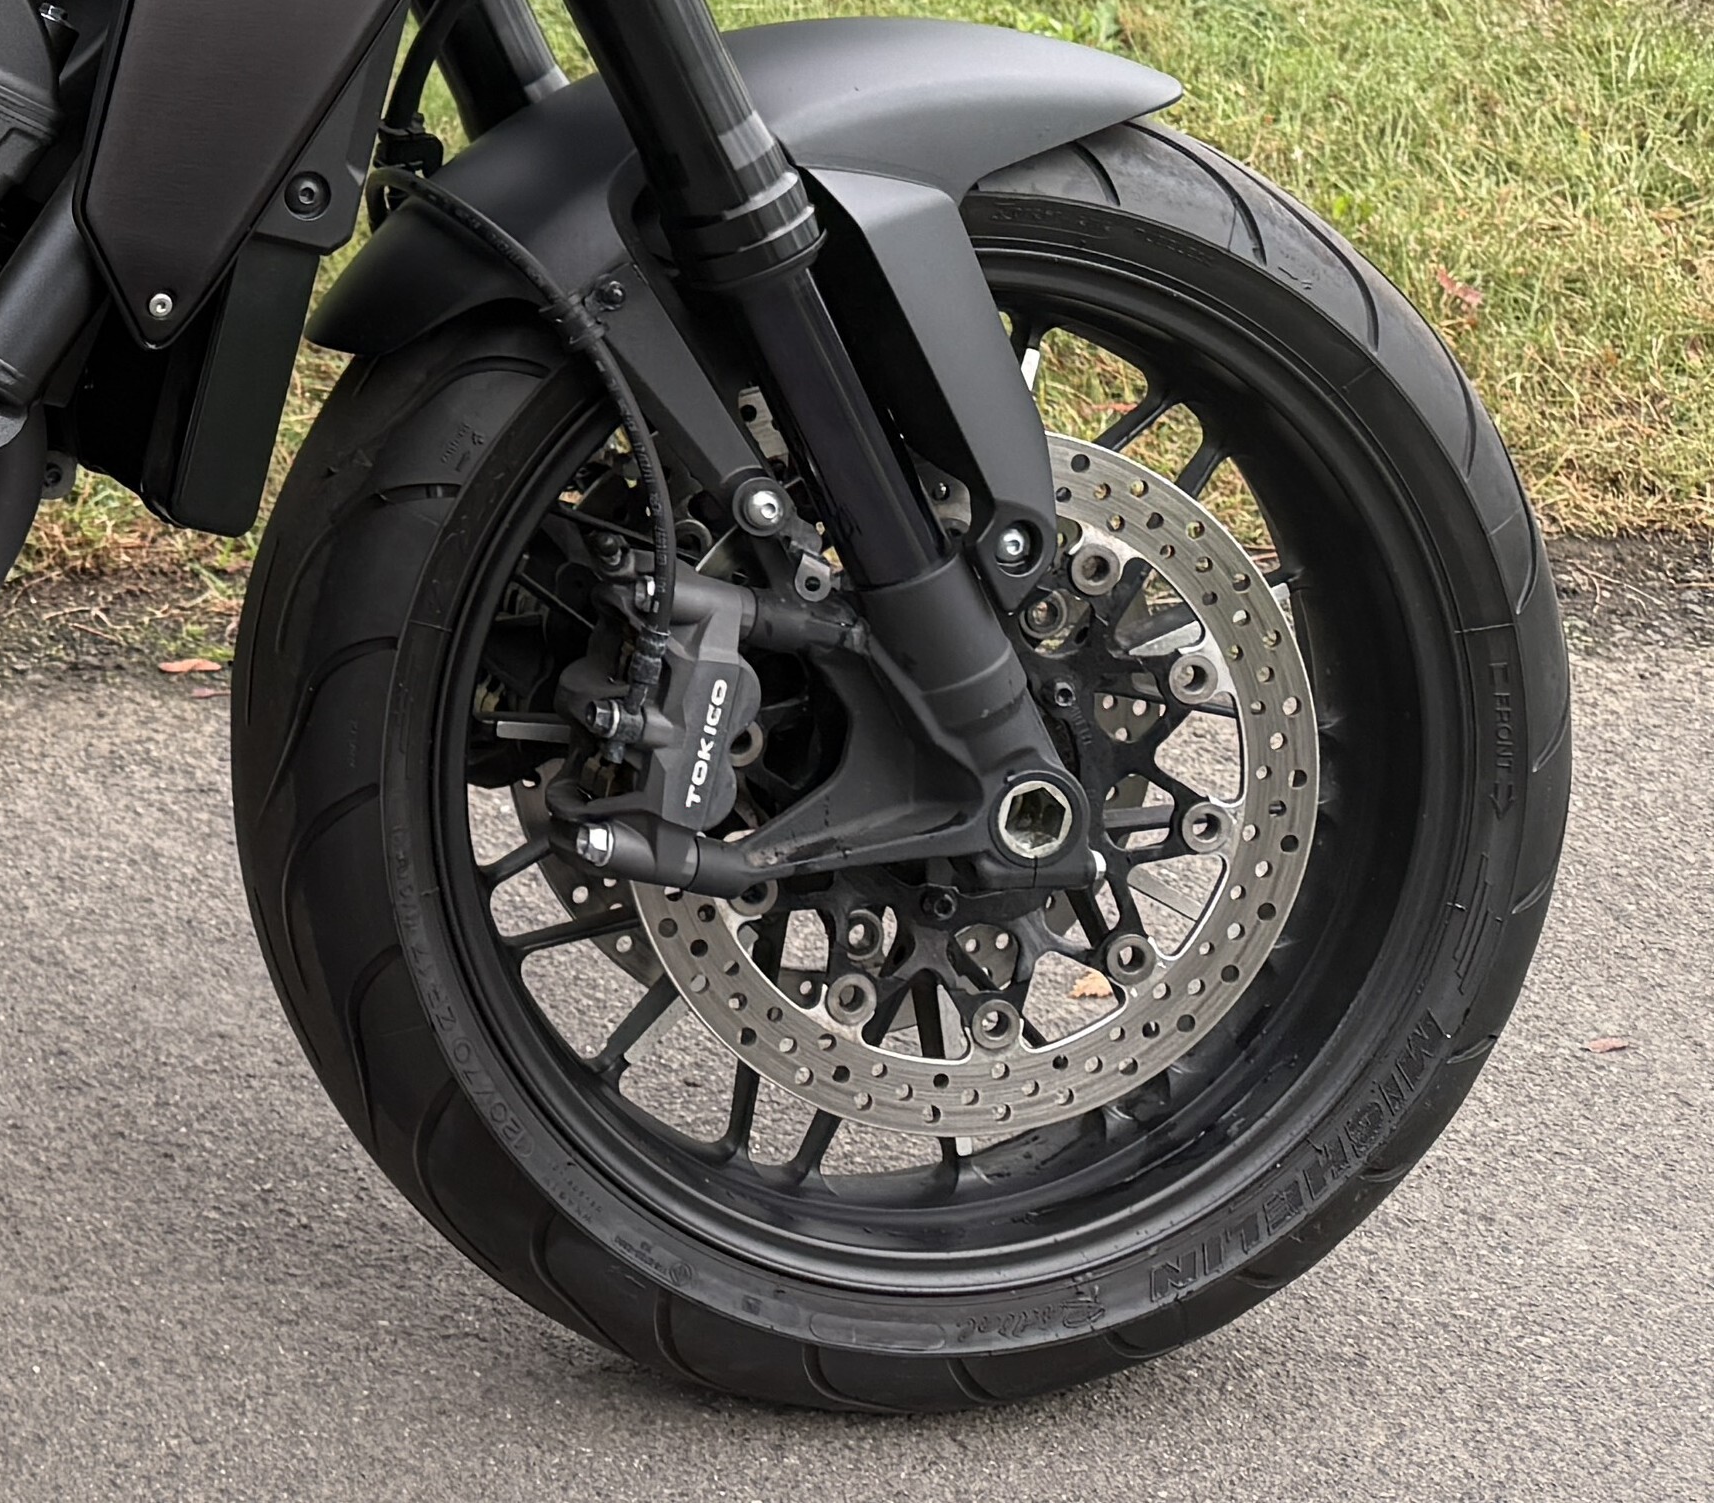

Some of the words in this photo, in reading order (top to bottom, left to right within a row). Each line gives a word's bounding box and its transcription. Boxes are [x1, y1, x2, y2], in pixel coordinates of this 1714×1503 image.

[685, 679, 728, 808] TOKICO
[1491, 689, 1515, 772] FRONT
[447, 1037, 531, 1150] 120/70
[1148, 1009, 1450, 1302] MICHELIN
